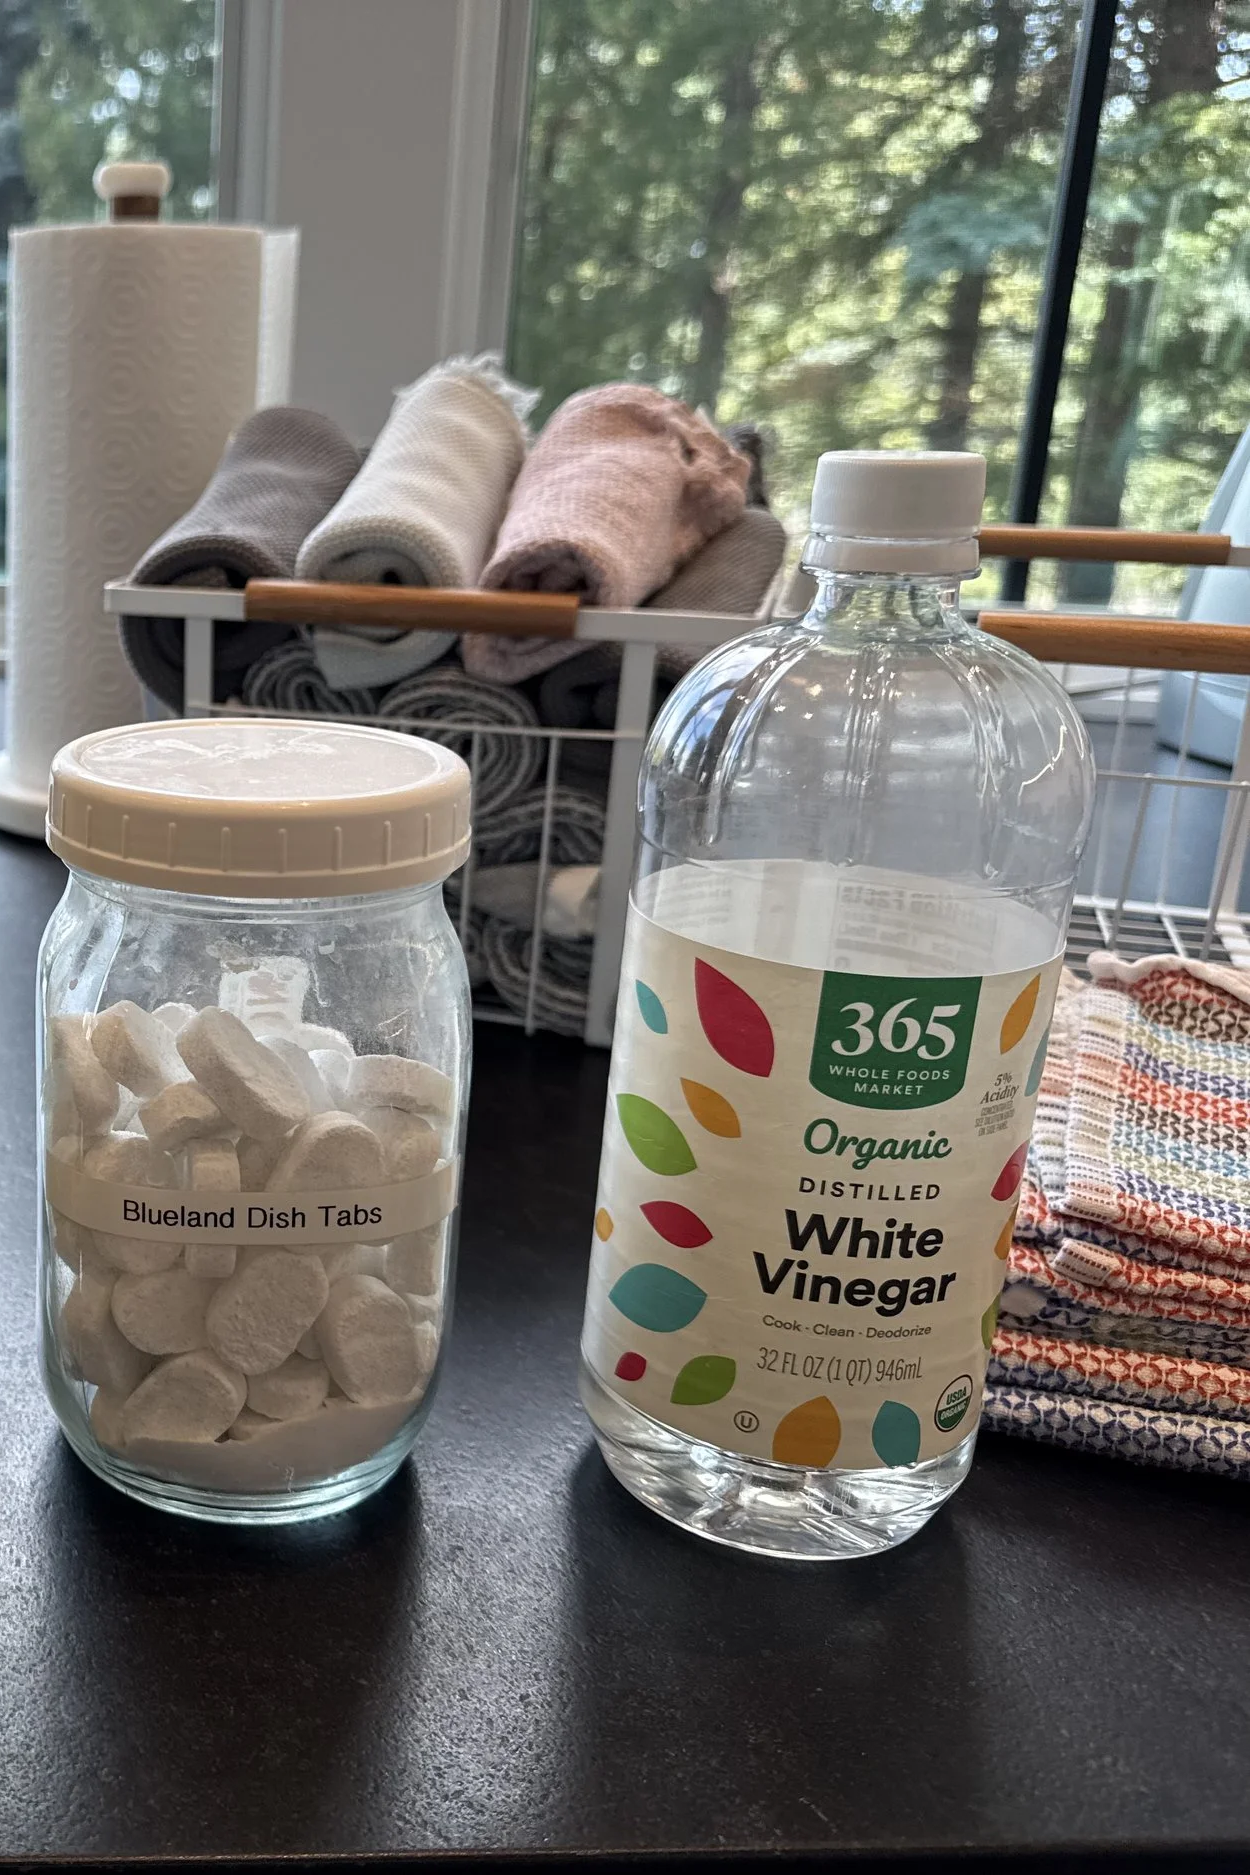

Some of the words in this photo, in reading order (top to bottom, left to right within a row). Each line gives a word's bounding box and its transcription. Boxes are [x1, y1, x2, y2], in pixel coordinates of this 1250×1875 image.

[831, 997, 962, 1060] 365
[828, 1064, 890, 1080] WHOLE
[897, 1069, 951, 1081] FOODS
[994, 1071, 1013, 1087] 5%
[854, 1082, 924, 1096] MARKET
[979, 1084, 1020, 1105] Acidity
[803, 1117, 953, 1171] Organic
[798, 1176, 941, 1201] DISTILLED
[123, 1199, 235, 1229] Blueland
[247, 1206, 306, 1229] Dish
[317, 1204, 383, 1228] Tabs
[784, 1208, 944, 1259] White
[752, 1250, 957, 1318] Vinegar
[762, 1314, 804, 1333] Cook
[812, 1323, 855, 1338] Clean
[865, 1324, 933, 1339] Deodorize
[756, 1346, 779, 1373] 32
[781, 1352, 799, 1376] FL
[802, 1355, 825, 1380] OZ
[827, 1356, 842, 1384] (1
[845, 1358, 872, 1386] QT)
[875, 1356, 923, 1382] 946mL
[946, 1386, 967, 1406] USDA
